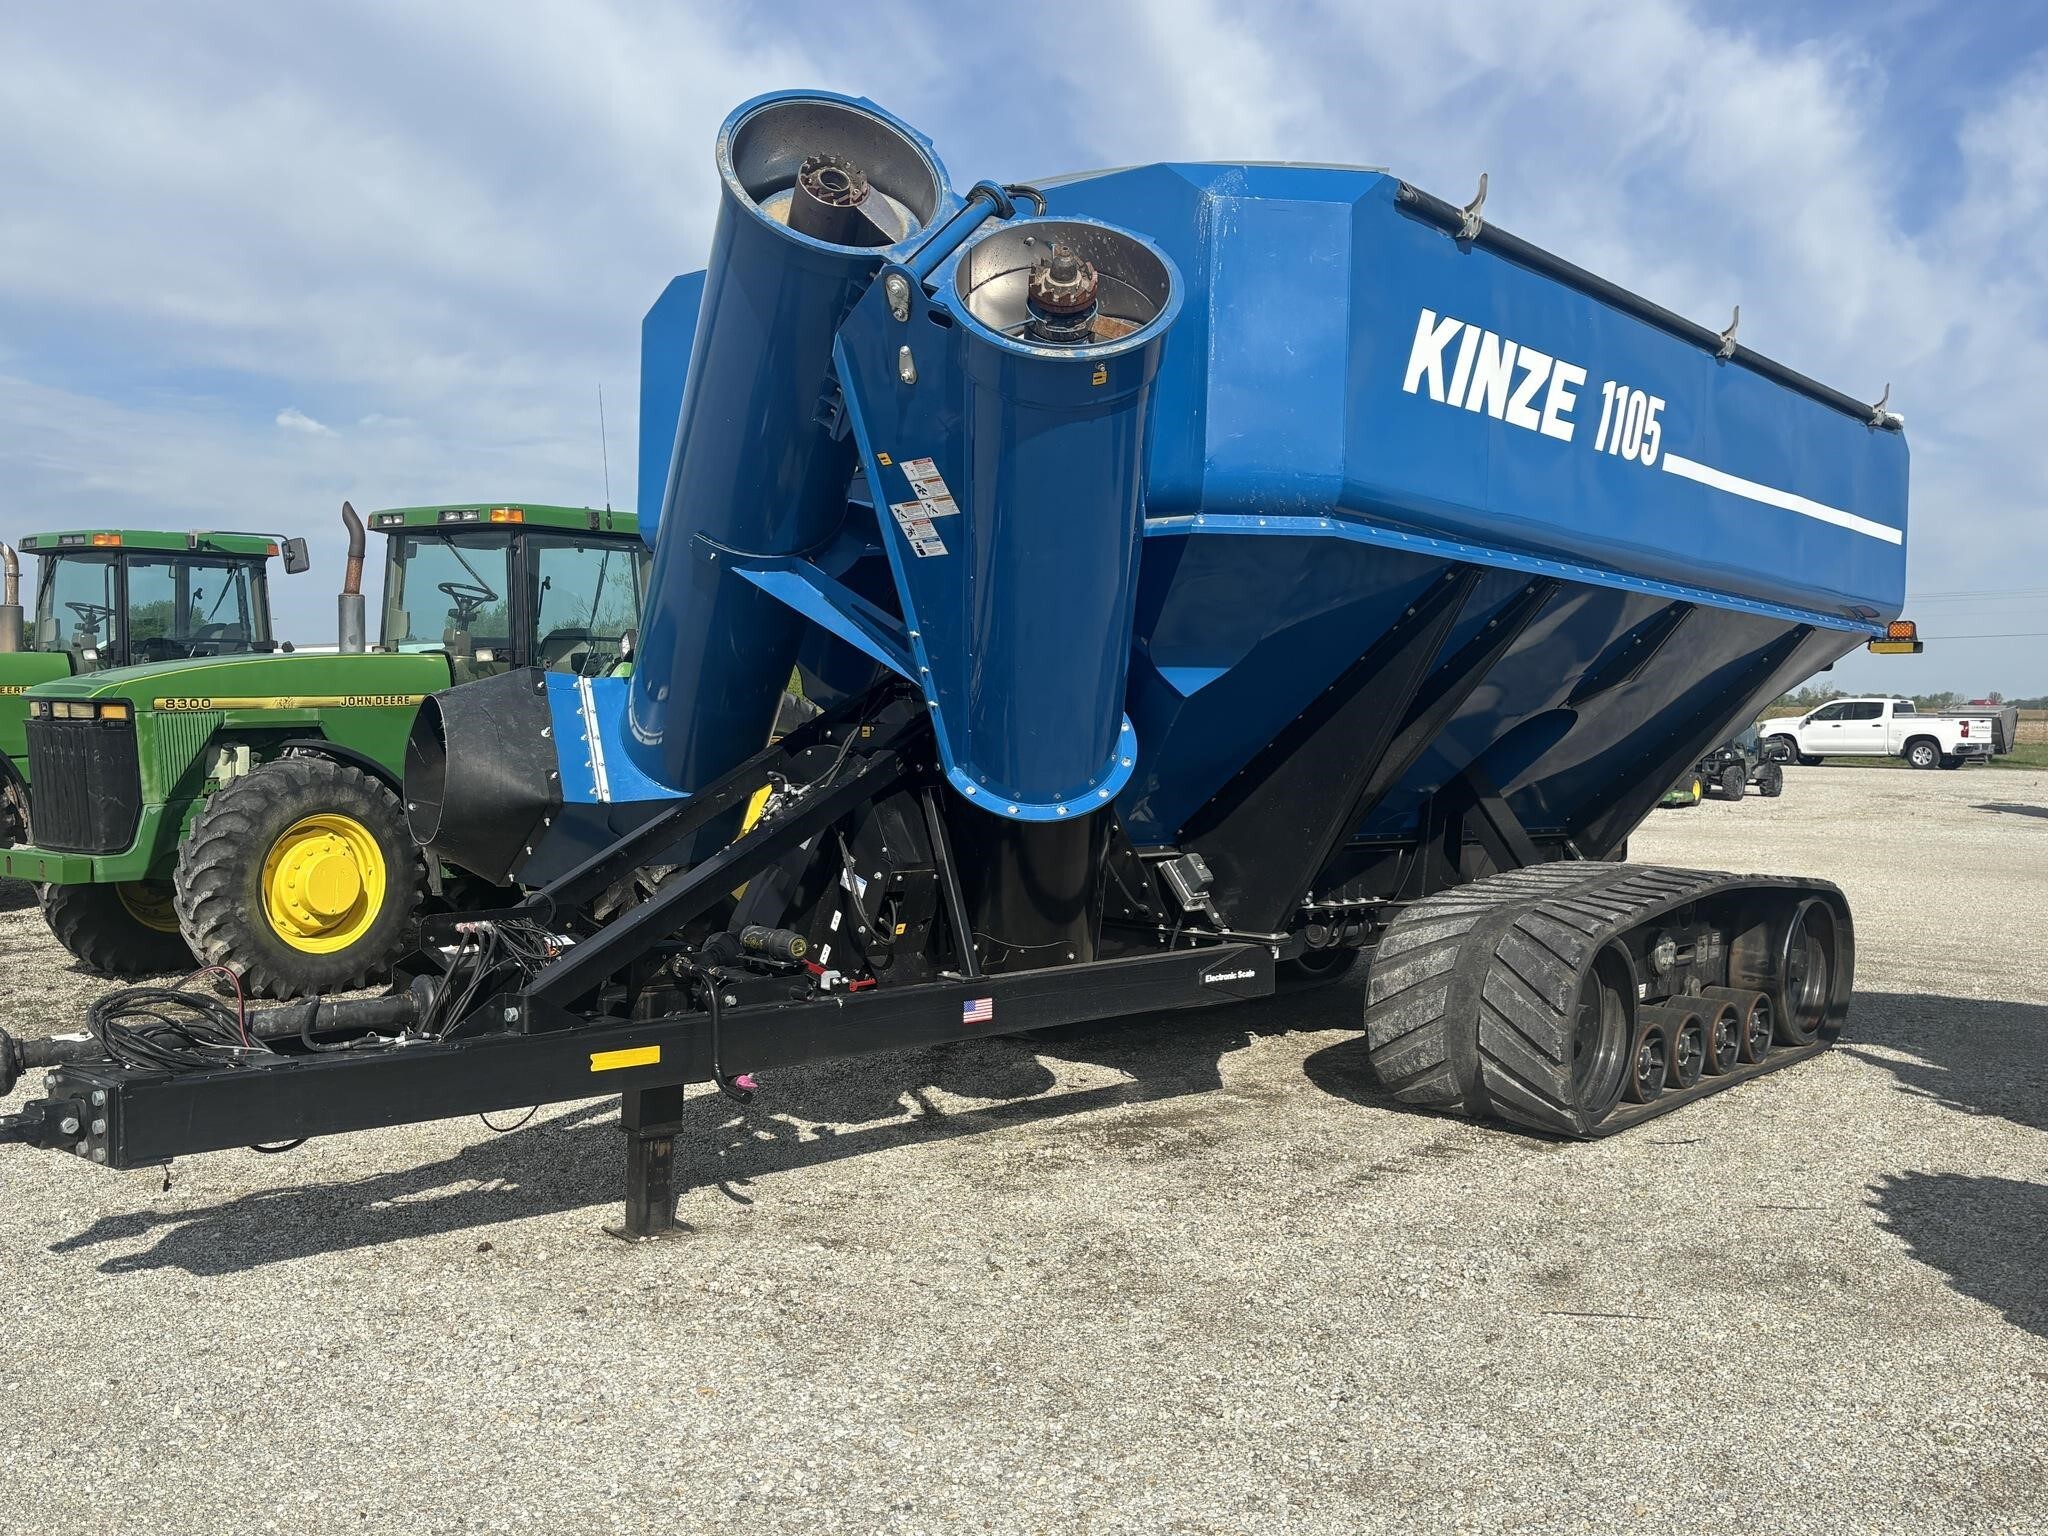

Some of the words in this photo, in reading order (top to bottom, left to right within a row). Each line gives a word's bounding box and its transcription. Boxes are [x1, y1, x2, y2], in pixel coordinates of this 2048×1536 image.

[1402, 306, 1587, 442] KINZE
[1594, 380, 1666, 466] 1105
[165, 698, 211, 709] 8300
[340, 696, 371, 706] JOHN
[375, 695, 410, 705] DEERE
